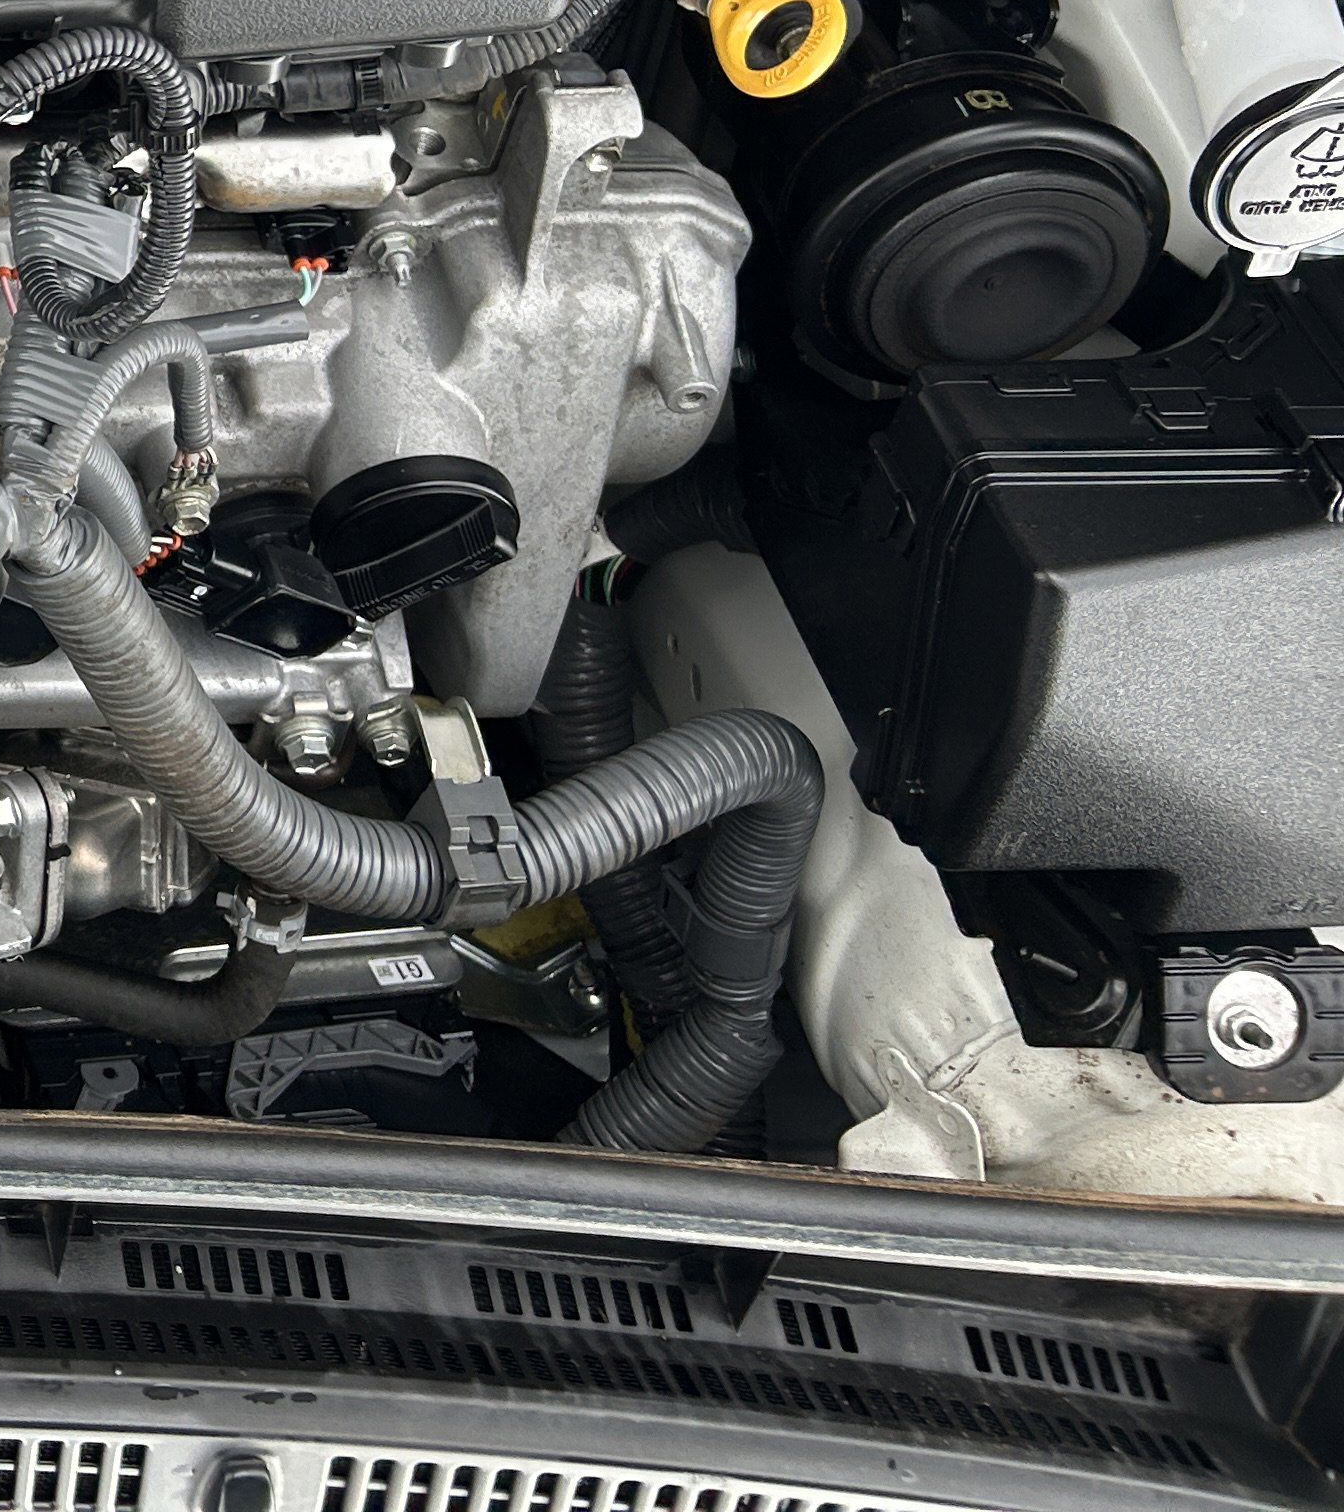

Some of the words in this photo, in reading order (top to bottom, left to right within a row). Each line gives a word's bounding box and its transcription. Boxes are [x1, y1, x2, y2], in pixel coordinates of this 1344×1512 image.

[1289, 183, 1337, 198] ONLY
[1239, 200, 1292, 215] FLUID
[367, 586, 430, 618] ENGINE
[432, 574, 461, 590] OIL
[395, 961, 422, 980] G1
